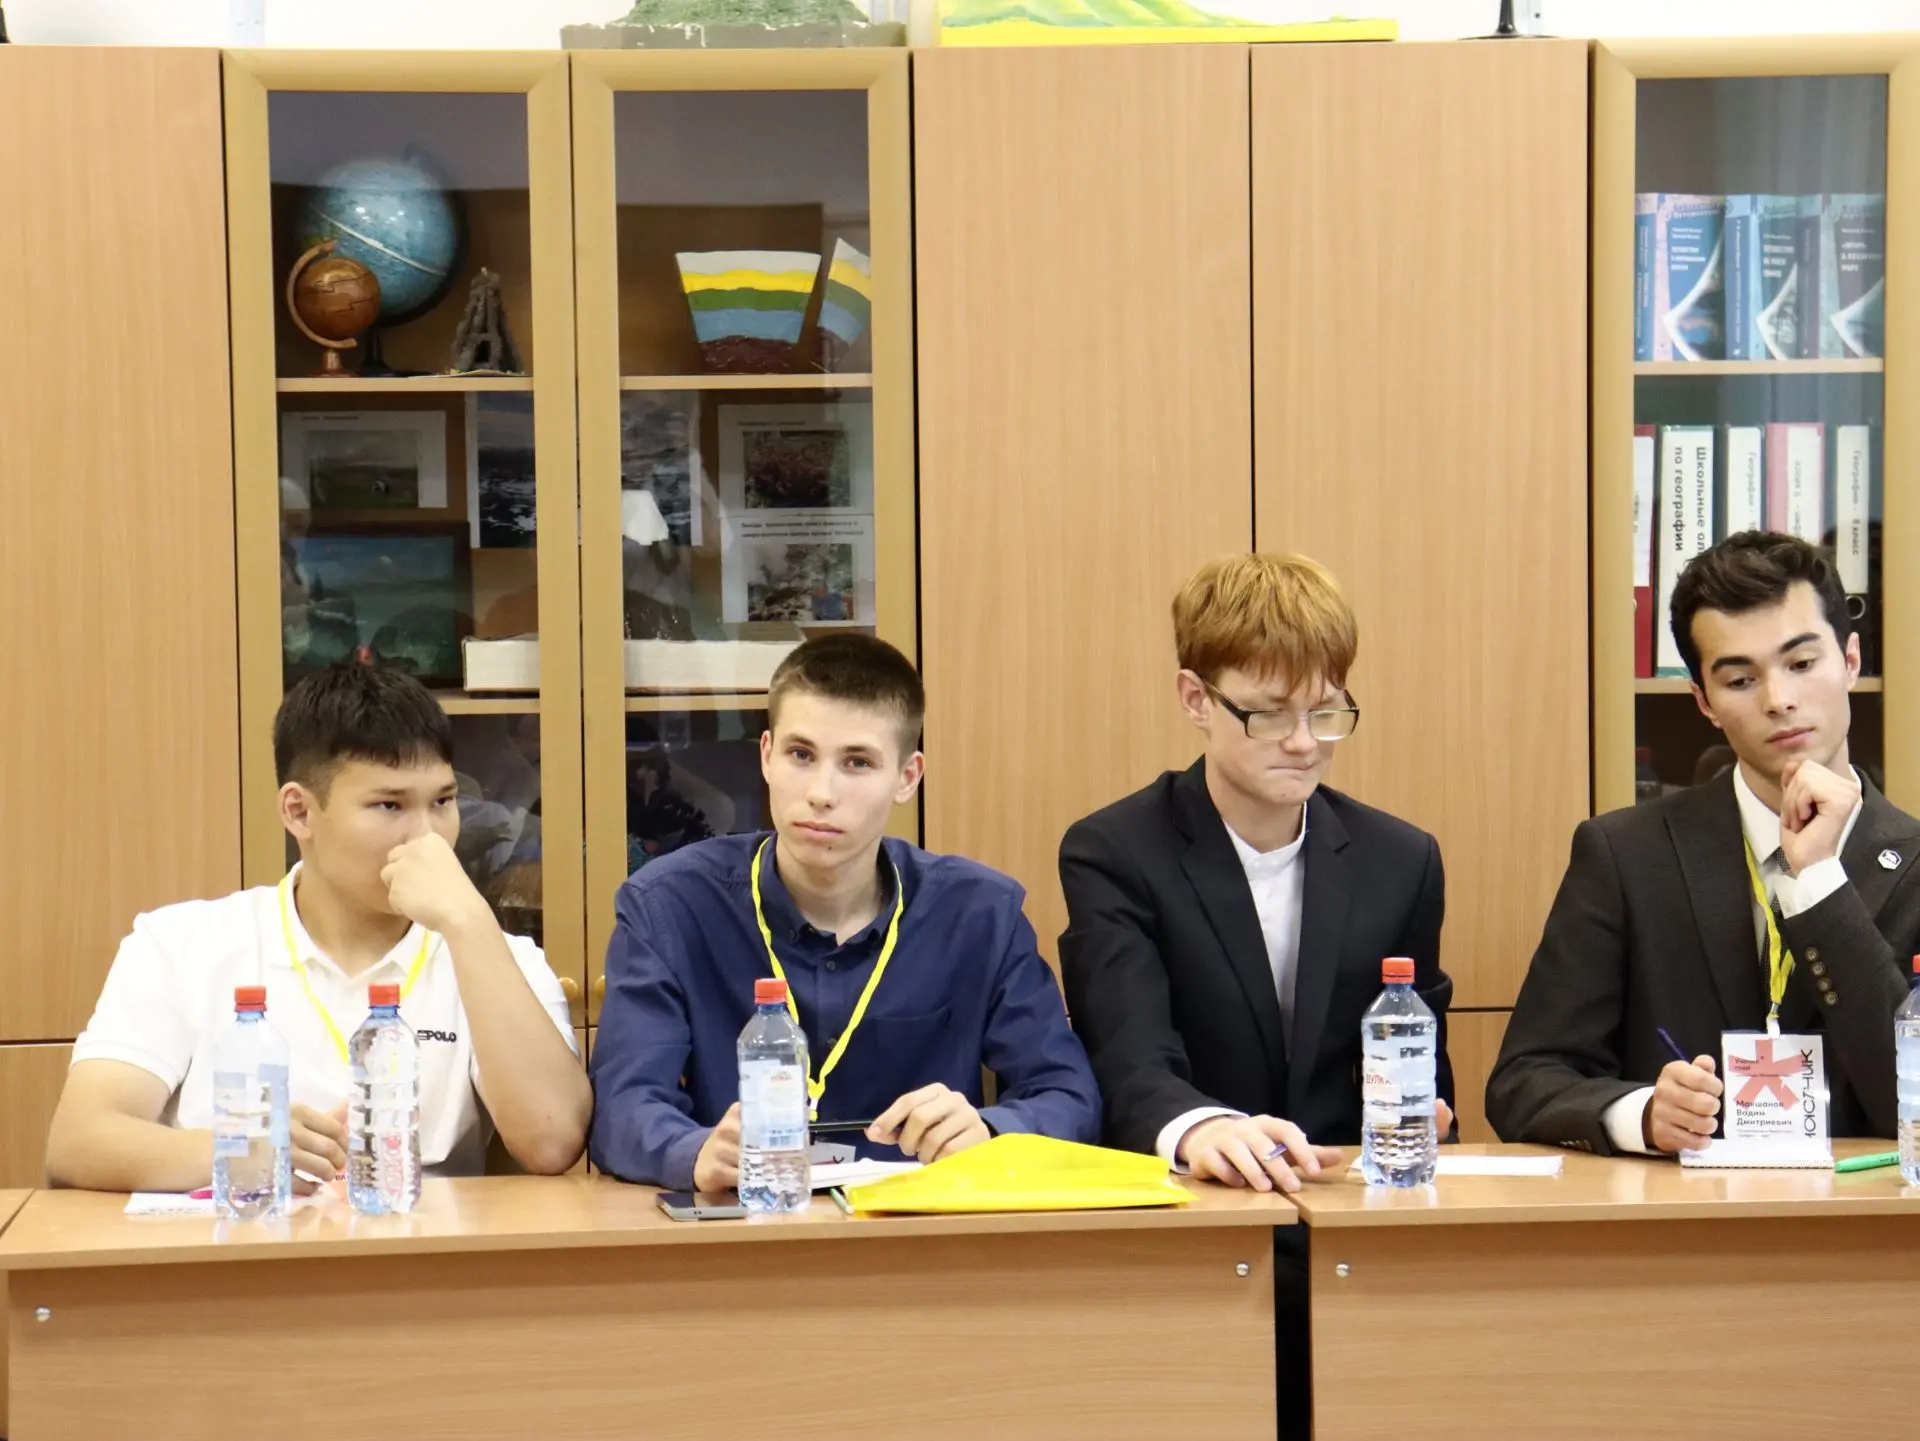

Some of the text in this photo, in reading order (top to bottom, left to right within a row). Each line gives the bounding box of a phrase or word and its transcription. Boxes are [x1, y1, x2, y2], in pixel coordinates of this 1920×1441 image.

[1672, 446, 1686, 552] по географии
[1695, 446, 1707, 528] Школьные
[1736, 1109, 1766, 1117] Вадим
[1736, 1117, 1792, 1127] Дмитриевич
